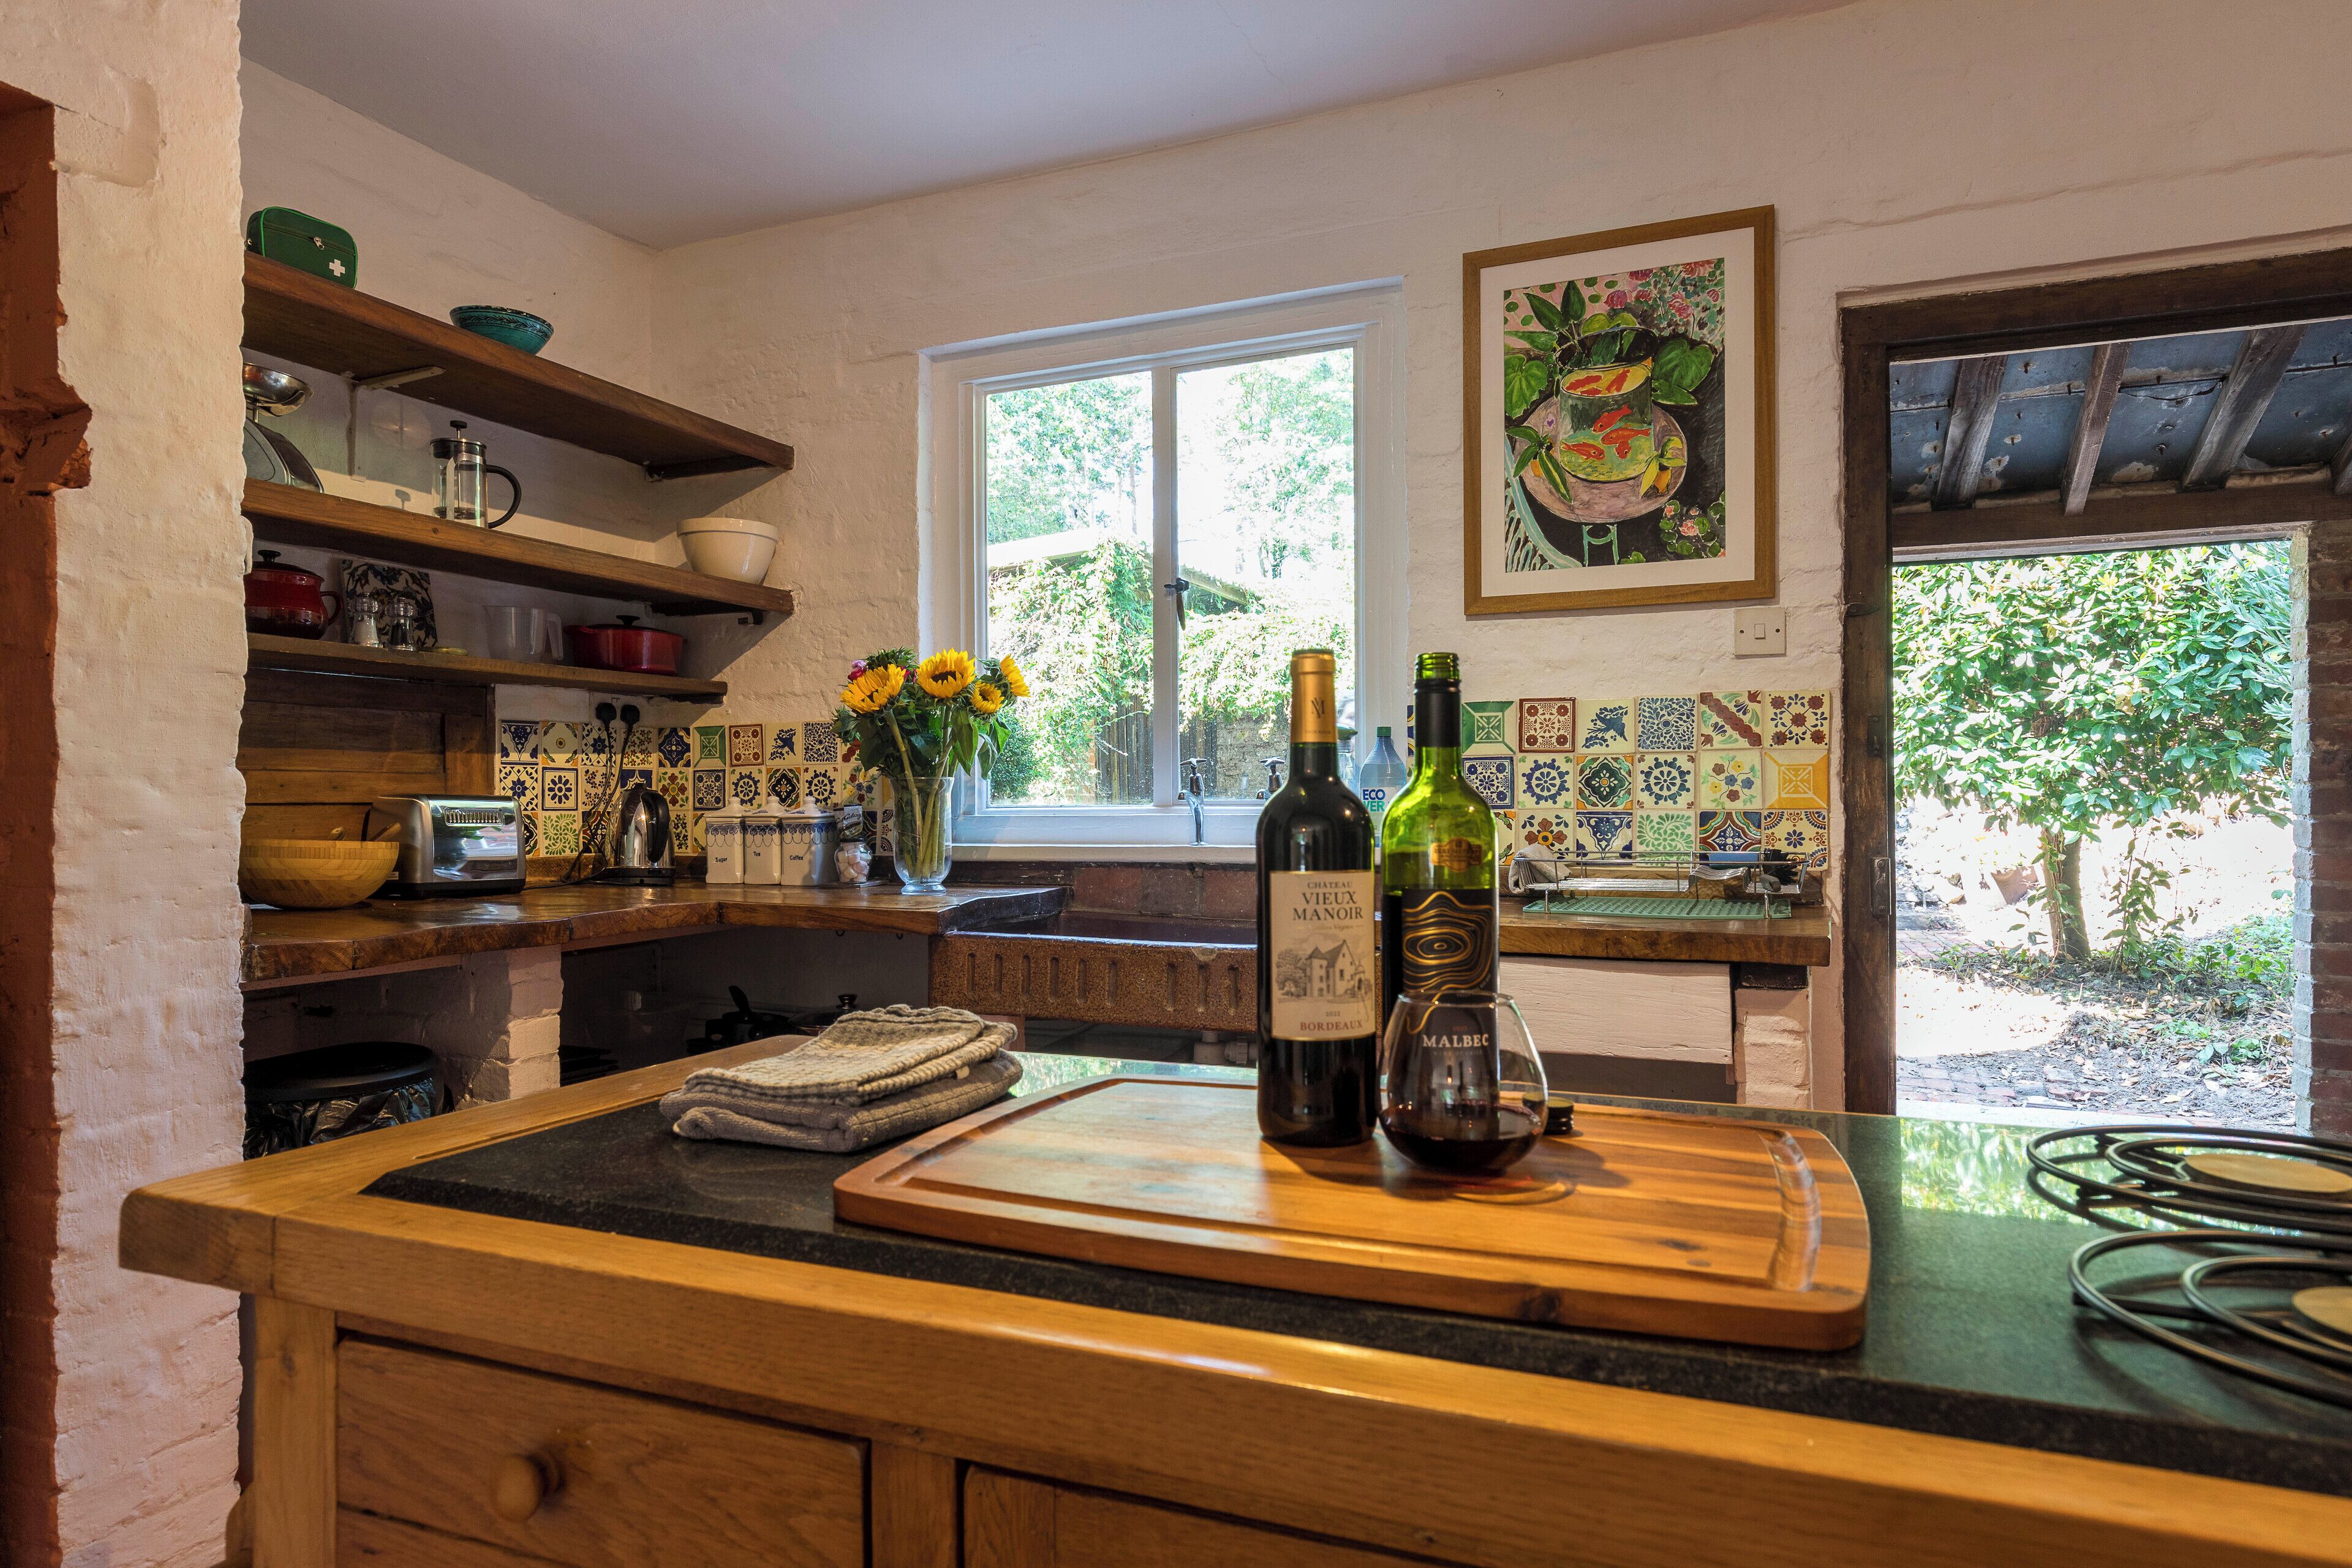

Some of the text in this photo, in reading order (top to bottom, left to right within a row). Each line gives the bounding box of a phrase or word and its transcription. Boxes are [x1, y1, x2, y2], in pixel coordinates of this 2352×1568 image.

[1363, 789, 1385, 800] ECO
[1363, 801, 1385, 812] VER
[1302, 891, 1357, 905] VIEUX
[1292, 907, 1363, 921] MANOIR
[1300, 1019, 1362, 1030] BORDEAUX
[1423, 1034, 1489, 1047] MALBEC
